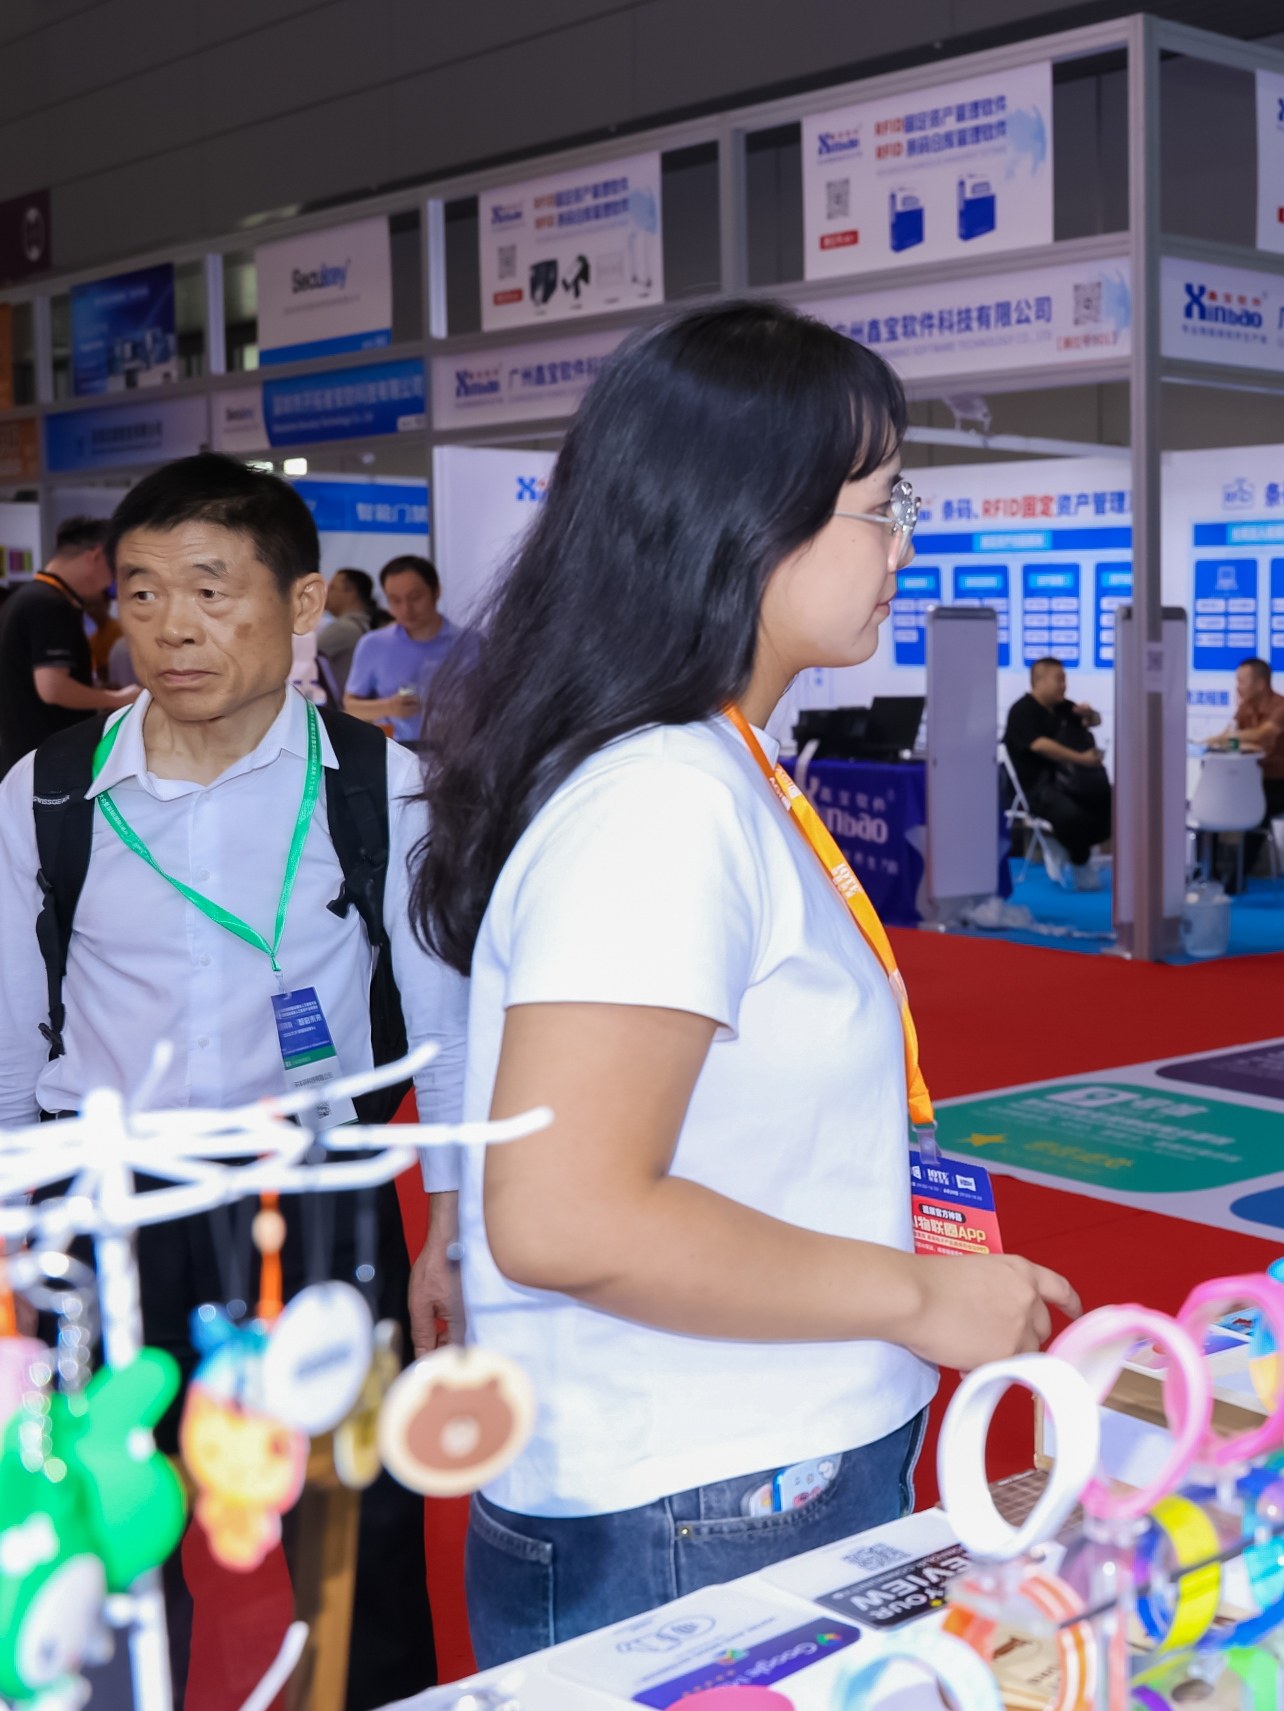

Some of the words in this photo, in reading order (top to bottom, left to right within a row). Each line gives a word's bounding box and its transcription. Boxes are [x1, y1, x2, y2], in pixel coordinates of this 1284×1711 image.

[876, 141, 904, 160] RFID
[1183, 282, 1263, 330] Xinbao
[943, 490, 1132, 521] 条码、RFID固定资产管理
[851, 1555, 973, 1612] EVIEW
[870, 1587, 944, 1620] YOUR
[744, 1641, 818, 1677] Google
